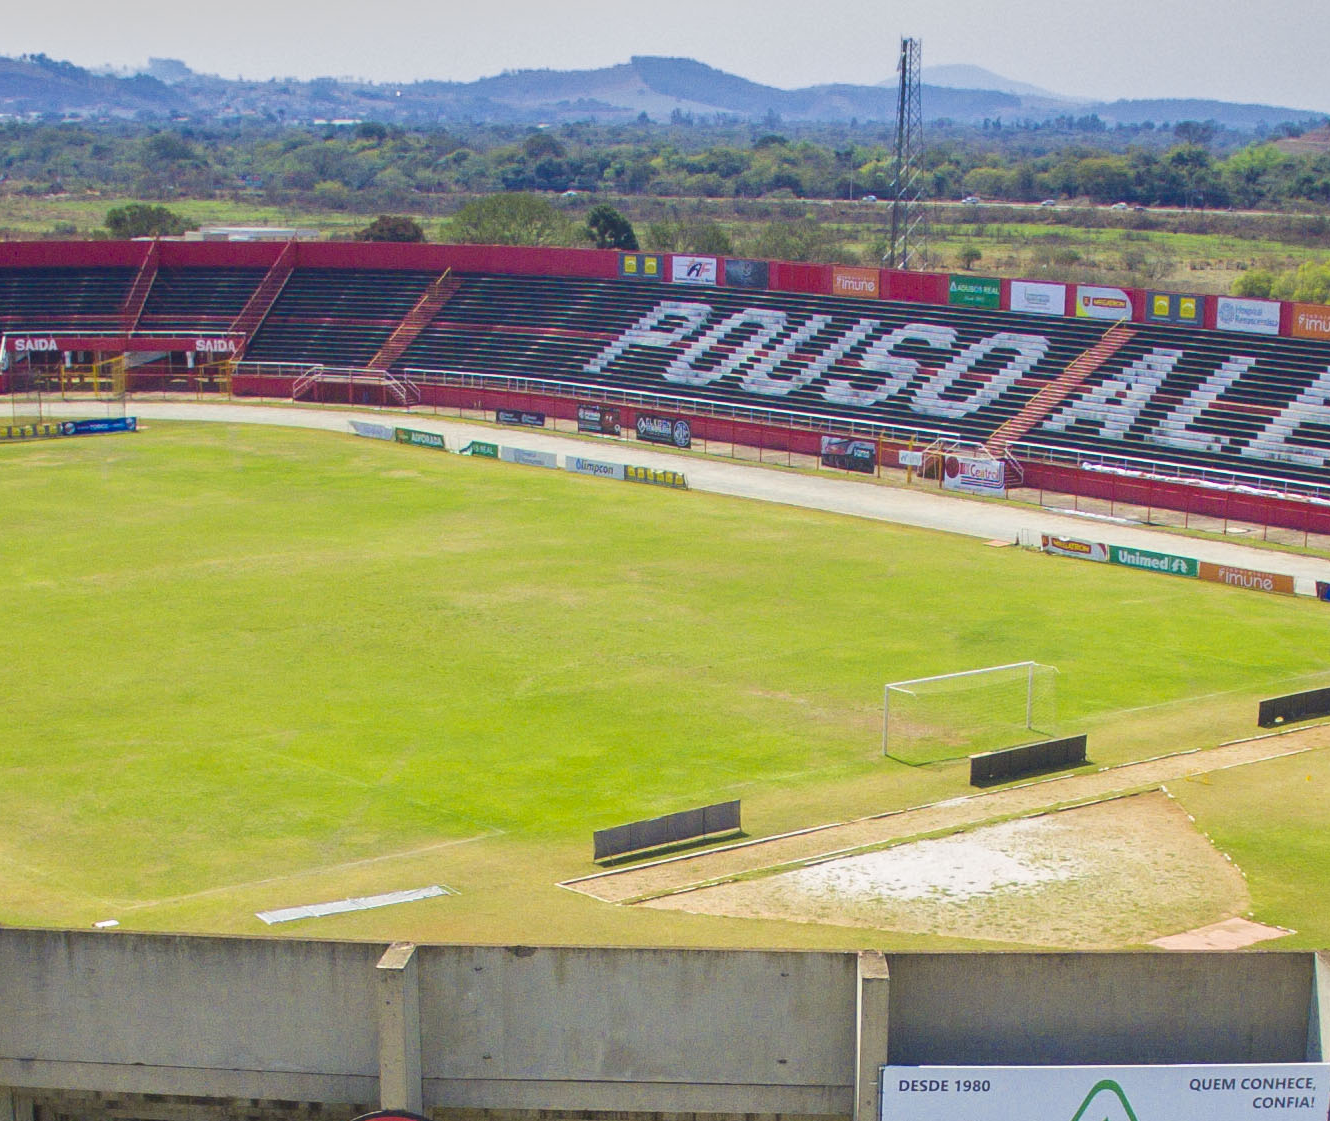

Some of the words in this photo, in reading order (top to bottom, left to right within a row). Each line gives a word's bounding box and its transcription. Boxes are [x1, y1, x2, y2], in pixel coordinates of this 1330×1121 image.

[582, 300, 1051, 419] POUSO
[1118, 549, 1169, 571] Unimed
[1225, 570, 1274, 591] imune
[898, 1080, 949, 1092] DESDE
[955, 1079, 991, 1092] 1980
[1189, 1078, 1236, 1092] QUEM
[1240, 1077, 1317, 1092] CONHECE,
[1252, 1096, 1316, 1109] CONFIA!
